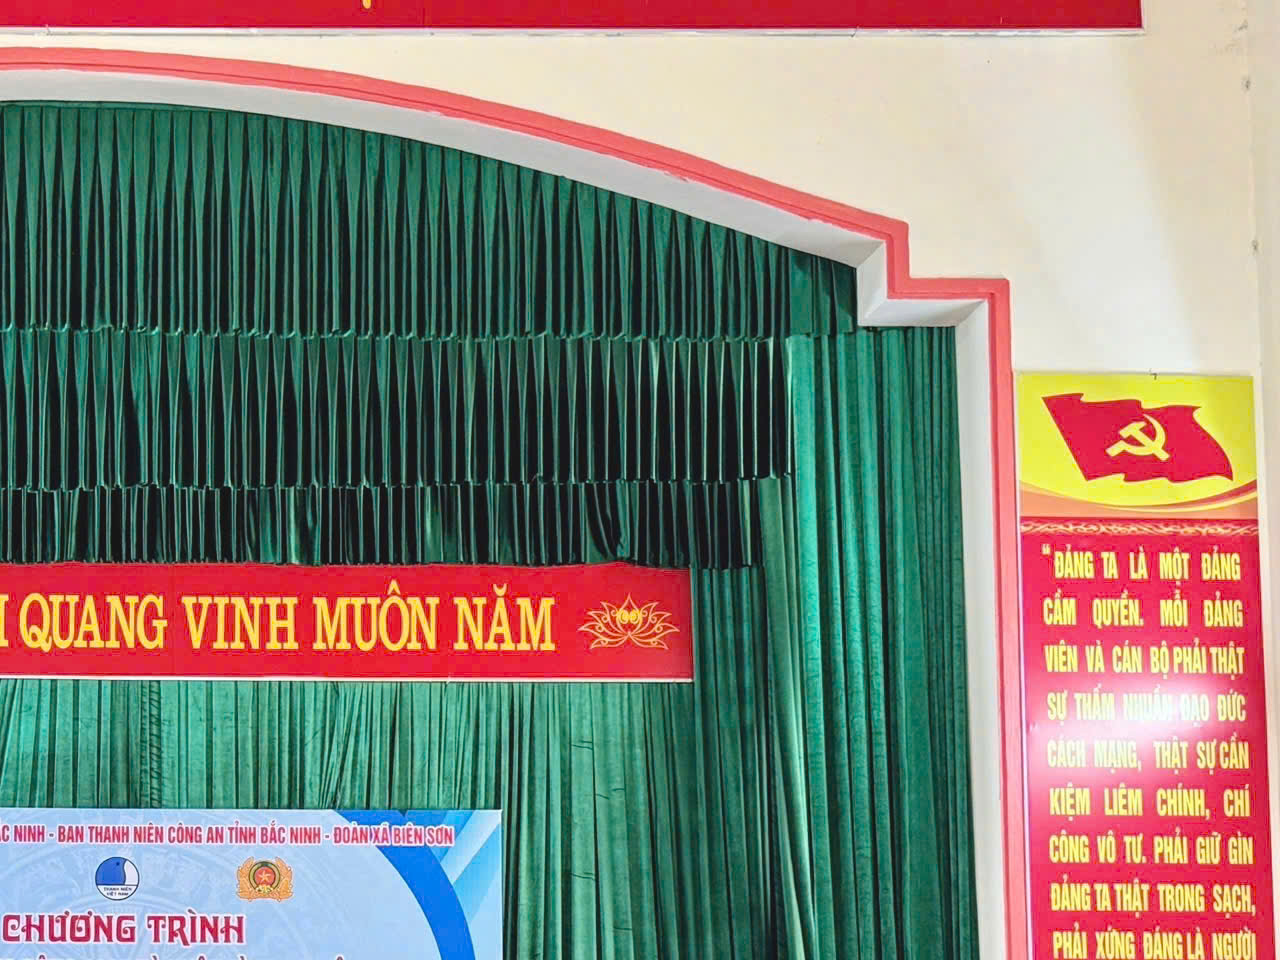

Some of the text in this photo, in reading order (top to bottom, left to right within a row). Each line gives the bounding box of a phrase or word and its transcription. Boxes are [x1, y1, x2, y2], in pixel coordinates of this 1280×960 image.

[1101, 552, 1118, 579] TA
[1129, 546, 1148, 580] LÀ
[1159, 547, 1189, 586] MỘT
[1201, 546, 1241, 581] ĐẢNG
[19, 593, 167, 652] QUANG
[182, 595, 297, 650] VINH
[313, 579, 438, 652] MUÔN
[454, 583, 555, 652] NĂM
[1049, 782, 1251, 821] KIỆM LIÊM CHÍNH, CHÍ
[14, 825, 45, 843] NINH
[58, 826, 84, 843] BAN
[88, 826, 130, 843] THANH
[133, 823, 164, 844] NIÊN
[168, 823, 202, 844] CÔNG
[206, 826, 224, 844] AN
[228, 821, 256, 844] TỈNH
[260, 821, 286, 844] BẮC
[290, 827, 321, 844] NINH
[334, 822, 369, 845] ĐOÀN
[373, 822, 391, 845] XÃ
[394, 825, 422, 845] BIÊN
[426, 826, 454, 845] SƠN
[2, 909, 244, 946] CHƯƠNG TRÌNH
